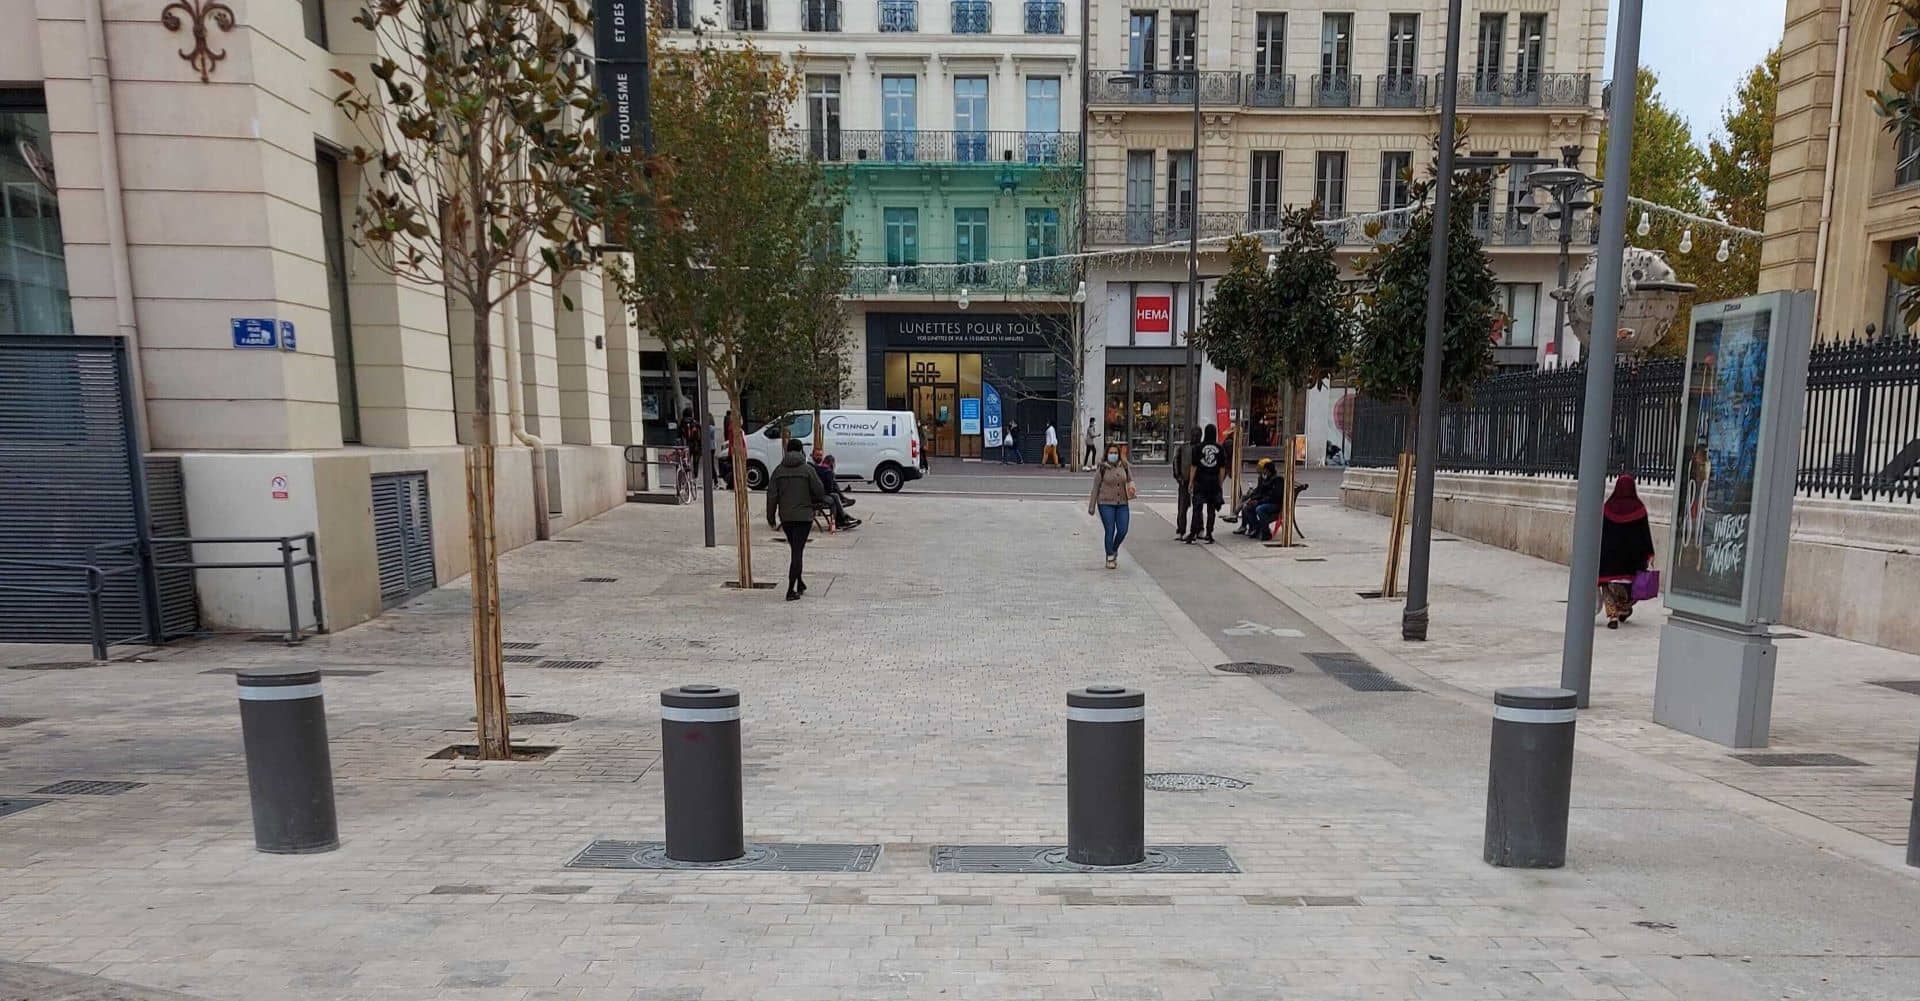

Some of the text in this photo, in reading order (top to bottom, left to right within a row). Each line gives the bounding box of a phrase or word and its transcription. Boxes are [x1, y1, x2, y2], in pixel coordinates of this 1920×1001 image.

[613, 2, 632, 157] E TOURISME ET DES
[1137, 309, 1169, 320] HEMA
[900, 322, 1041, 335] LUNETTES POUR TOUS
[829, 418, 878, 430] CITINNOV
[988, 415, 998, 424] 10
[989, 430, 998, 439] 10
[1713, 513, 1748, 543] INTENSE
[1709, 541, 1744, 577] NATURE
